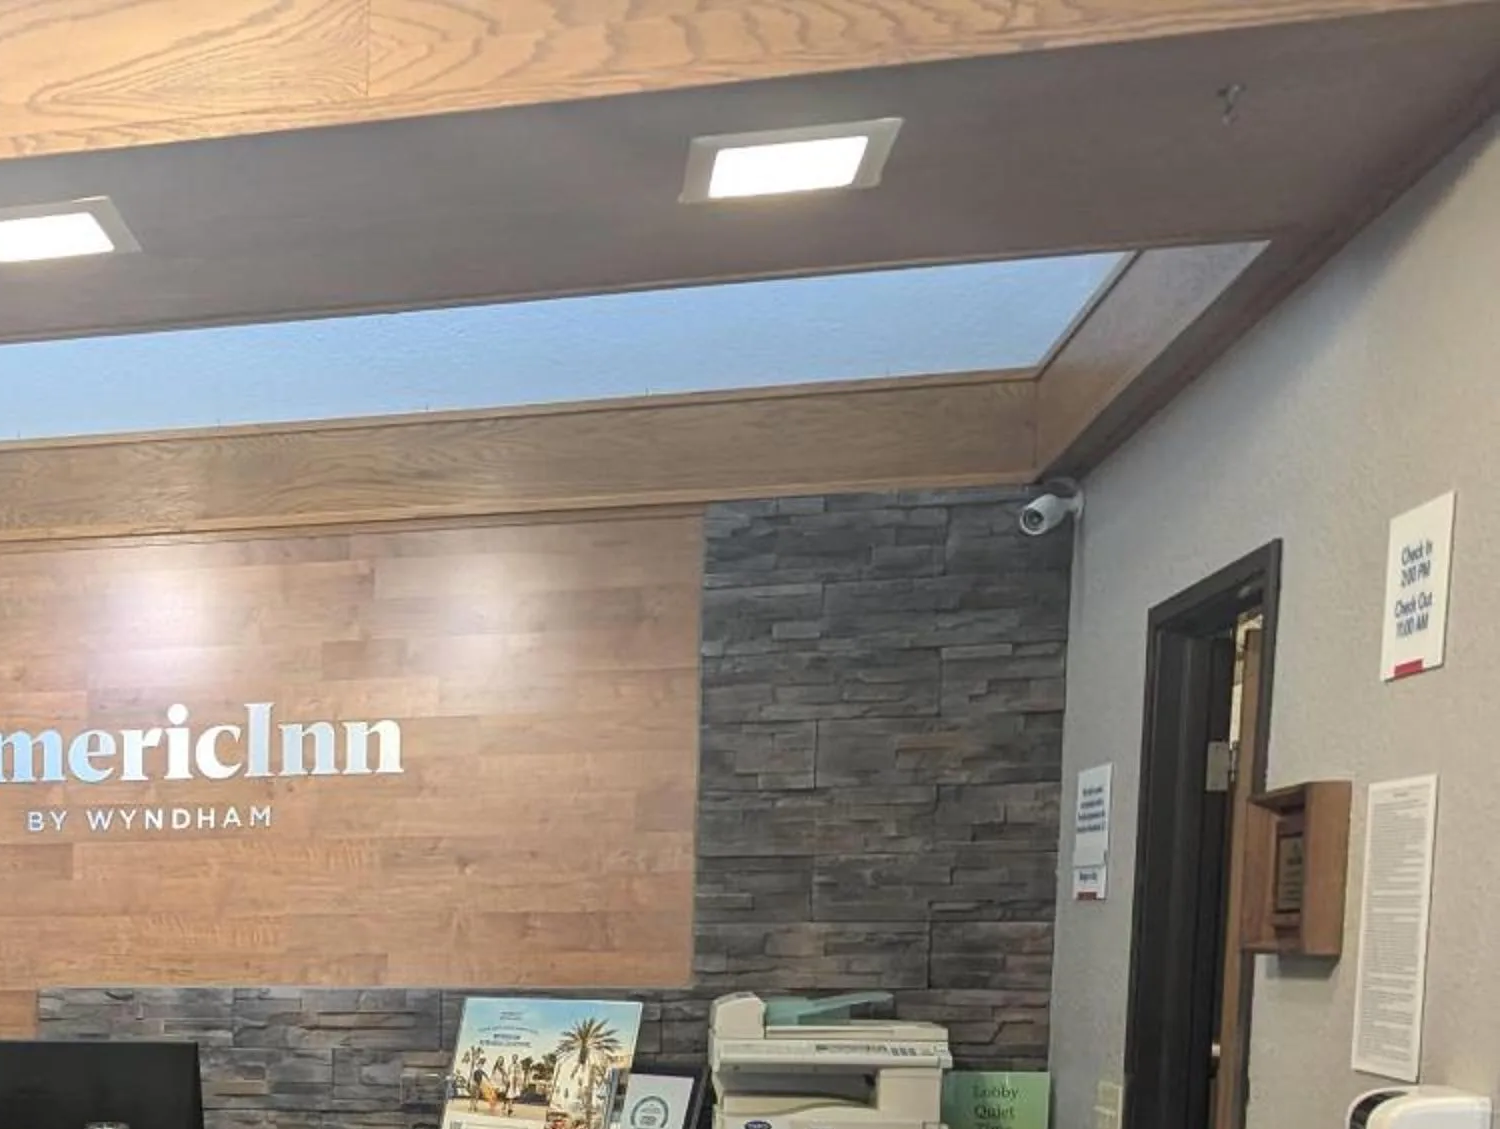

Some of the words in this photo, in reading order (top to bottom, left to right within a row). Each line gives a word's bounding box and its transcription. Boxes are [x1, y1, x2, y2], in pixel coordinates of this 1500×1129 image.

[28, 809, 68, 832] BY
[86, 804, 272, 831] WYNDHAM
[972, 1084, 1019, 1101] Lobby
[974, 1103, 1016, 1120] Quiet
